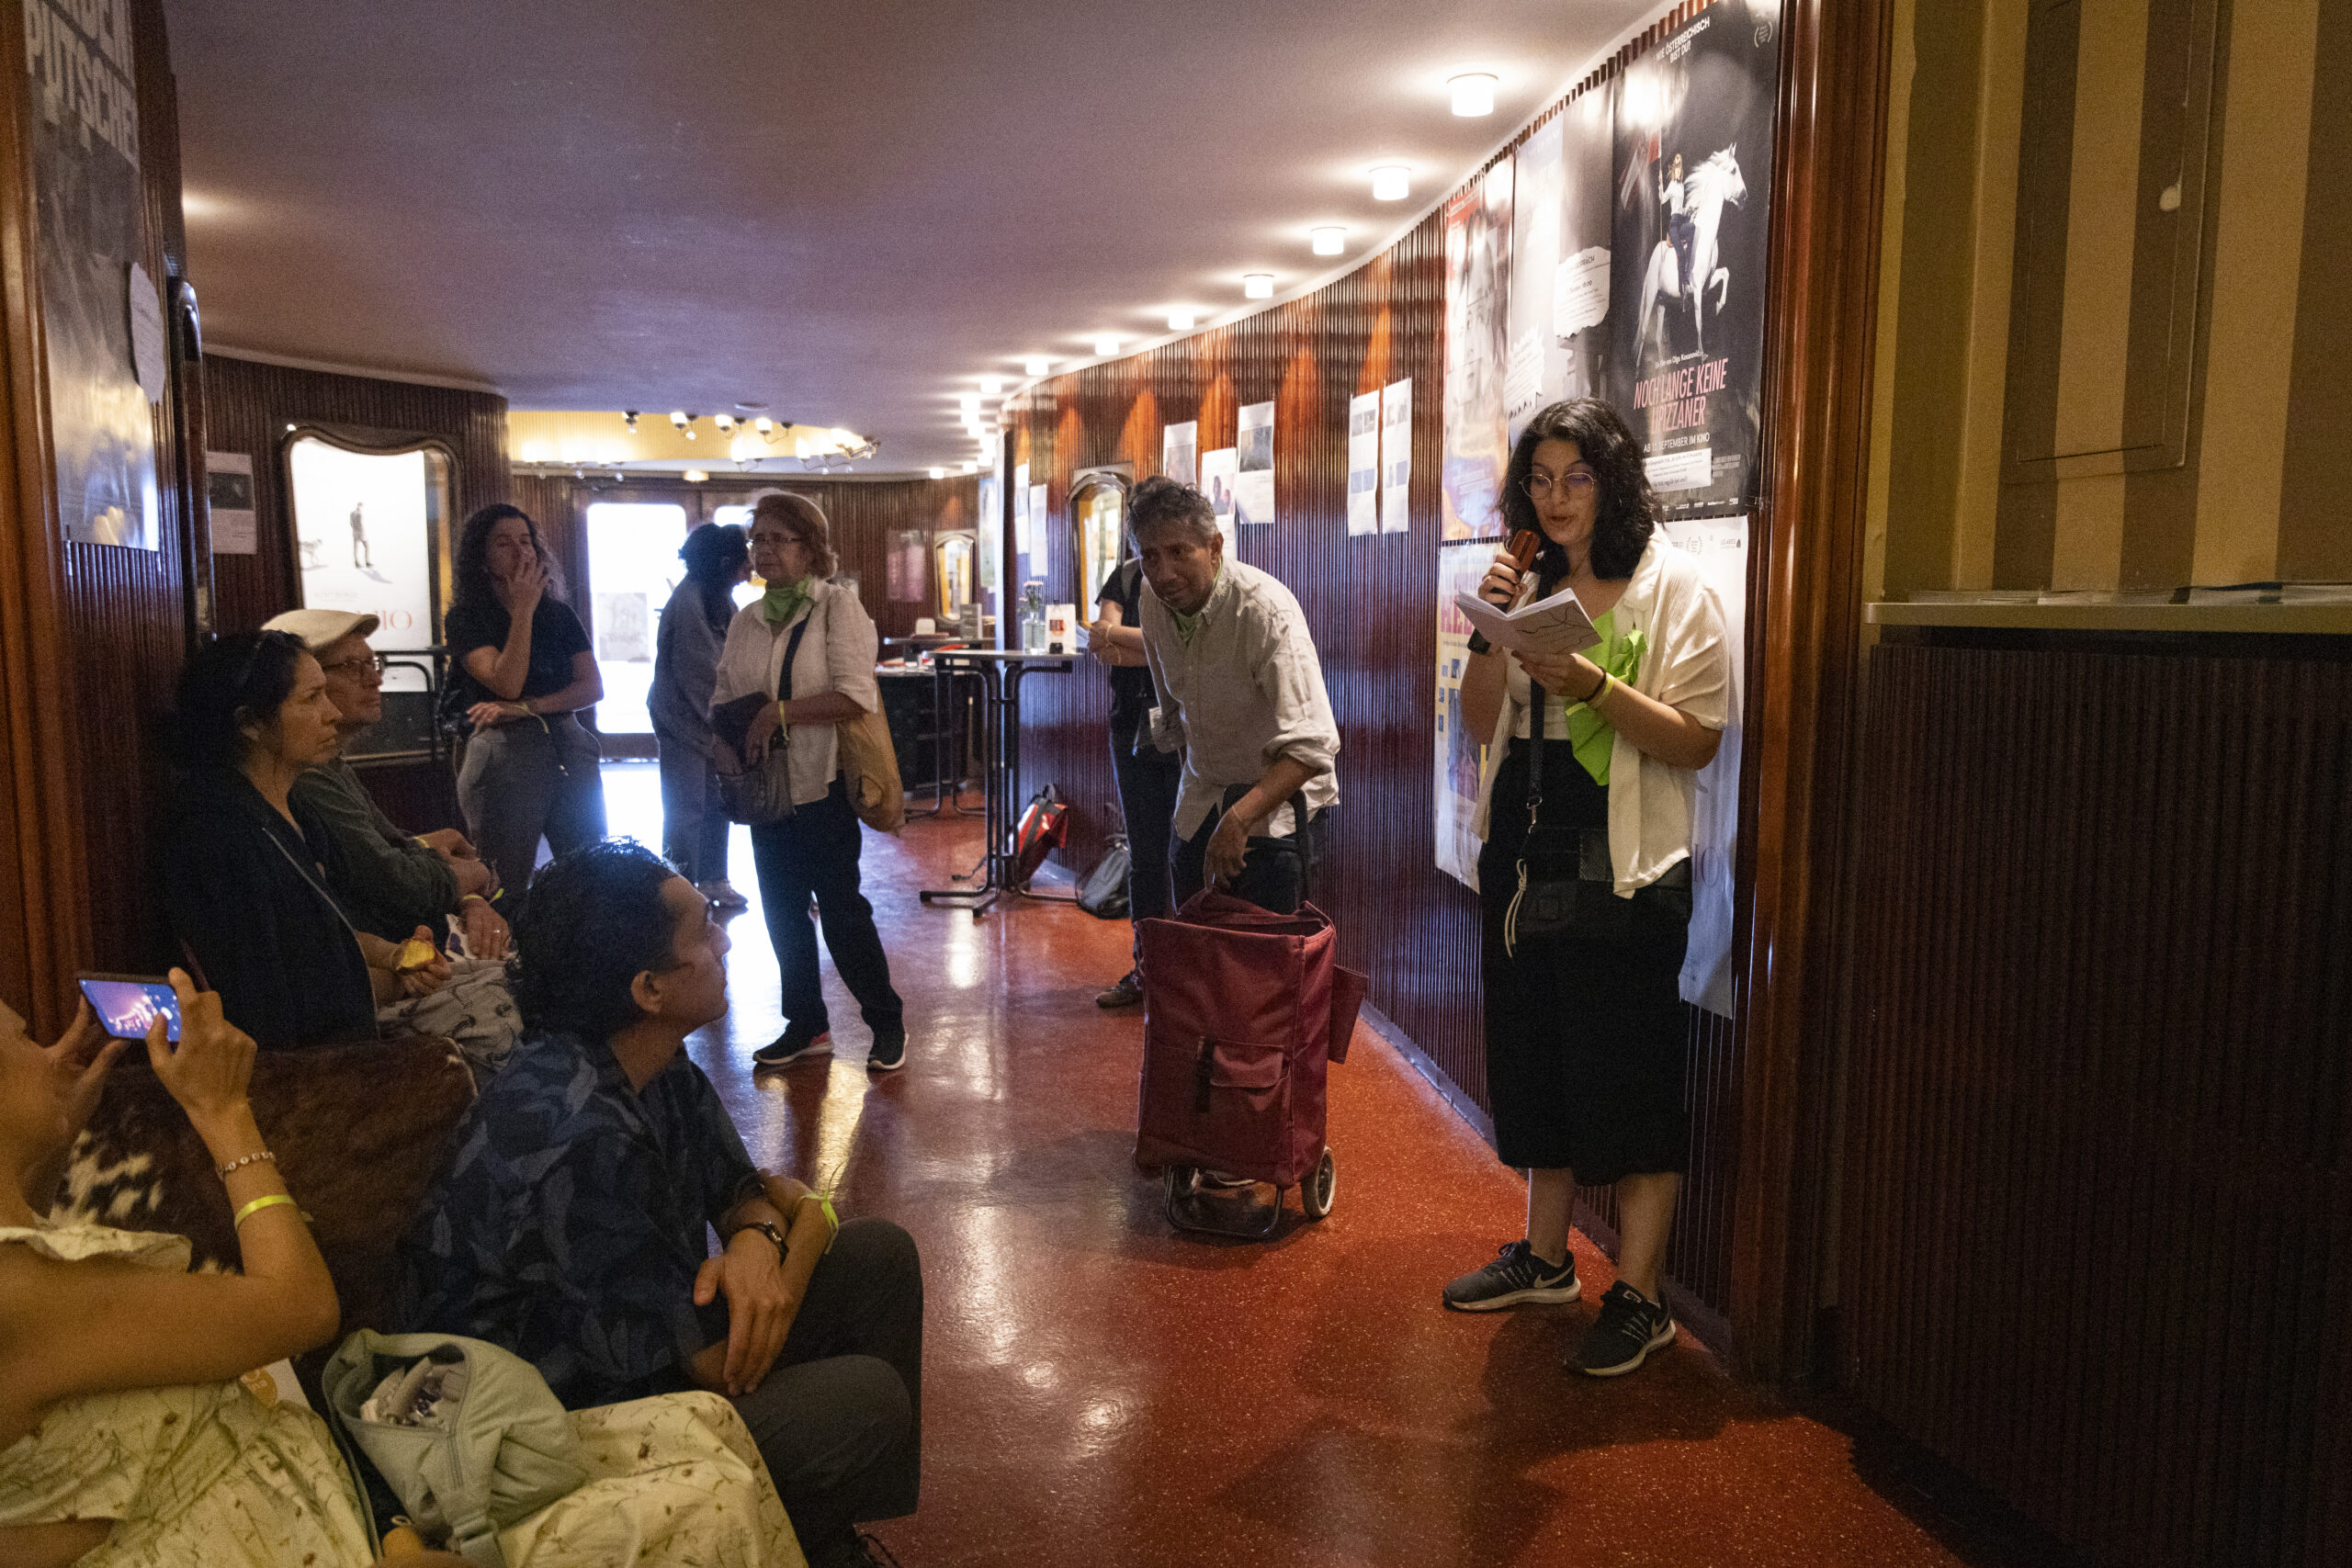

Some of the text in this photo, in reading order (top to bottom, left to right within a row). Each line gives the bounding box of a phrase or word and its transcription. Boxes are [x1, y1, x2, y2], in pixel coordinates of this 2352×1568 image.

[1666, 16, 1710, 55] ÖSTERREICHISCH
[1670, 39, 1690, 63] BIST DU?
[24, 0, 140, 173] PUTSCHE
[1672, 355, 1680, 365] Olga
[1634, 357, 1728, 410] NOCH LANGE KEINE
[1652, 396, 1706, 434] LIPIZZANER
[1644, 444, 1650, 453] AB
[1659, 436, 1688, 450] SEPTEMBER
[1690, 434, 1696, 445] IM
[1697, 432, 1710, 444] KINO
